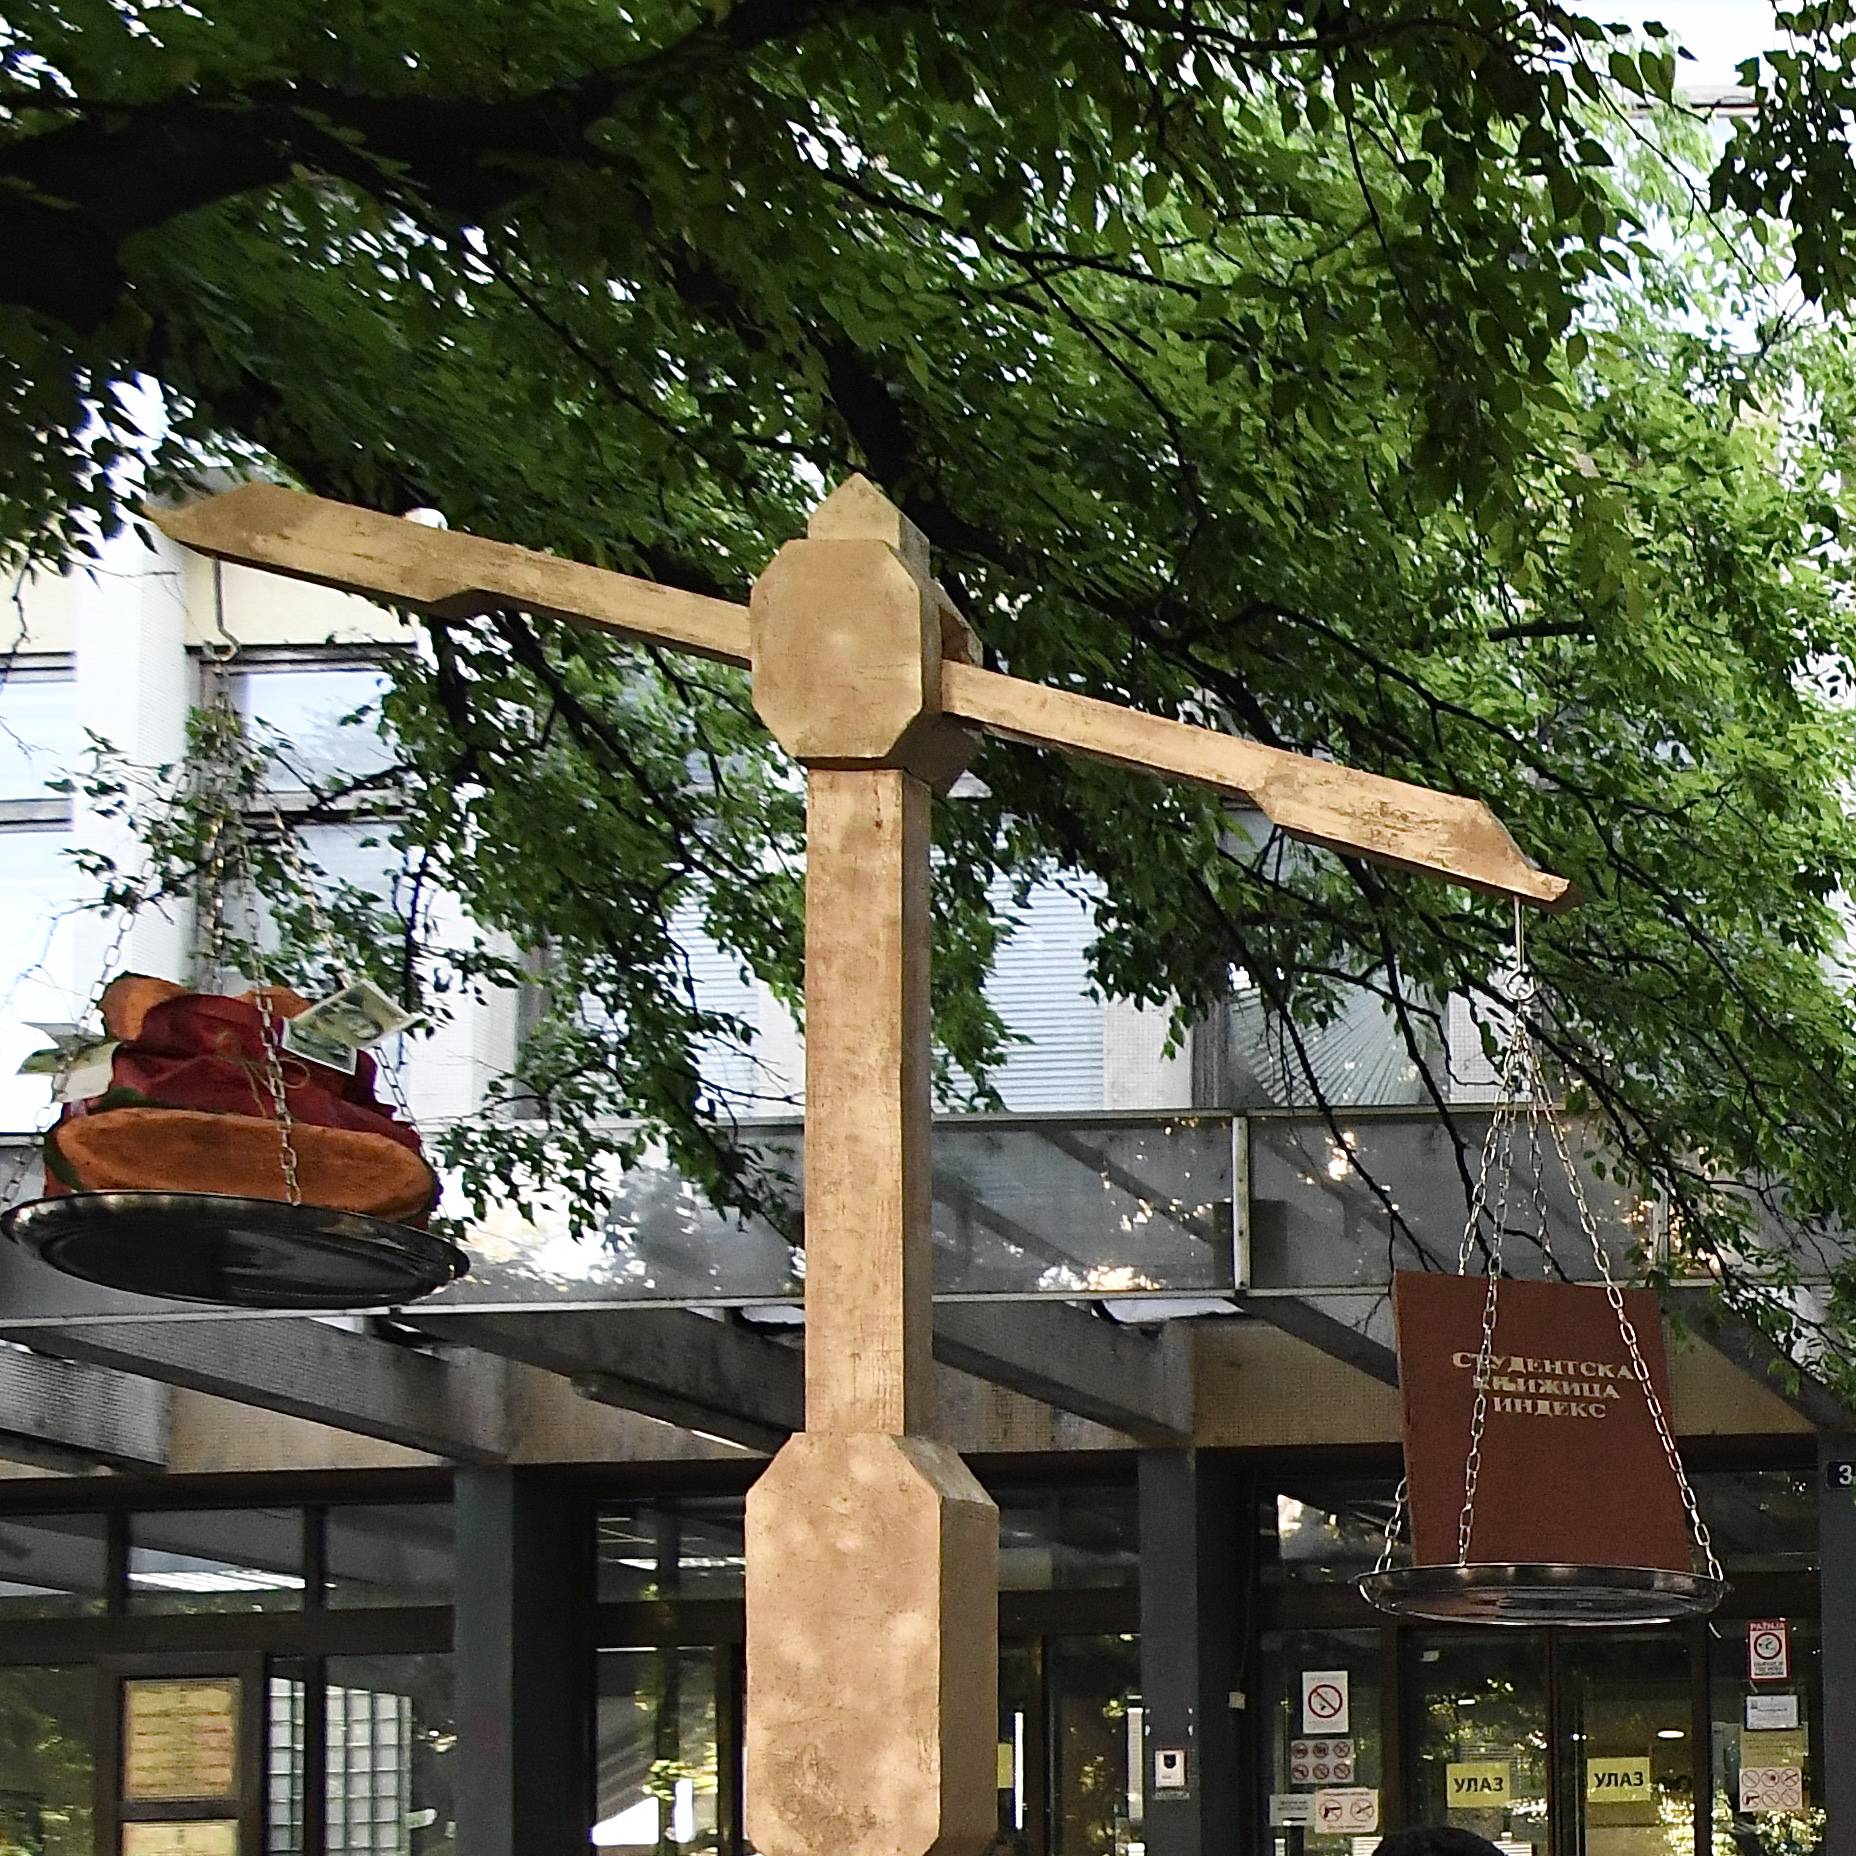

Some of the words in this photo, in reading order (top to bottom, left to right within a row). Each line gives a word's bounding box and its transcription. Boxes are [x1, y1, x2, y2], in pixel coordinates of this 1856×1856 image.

[1452, 1352, 1635, 1380] СТУДЕНТСКА
[1494, 1396, 1607, 1419] ИНДЕКС
[1453, 1776, 1504, 1793] УЛАЗ
[1594, 1771, 1644, 1788] УЛАЗ
